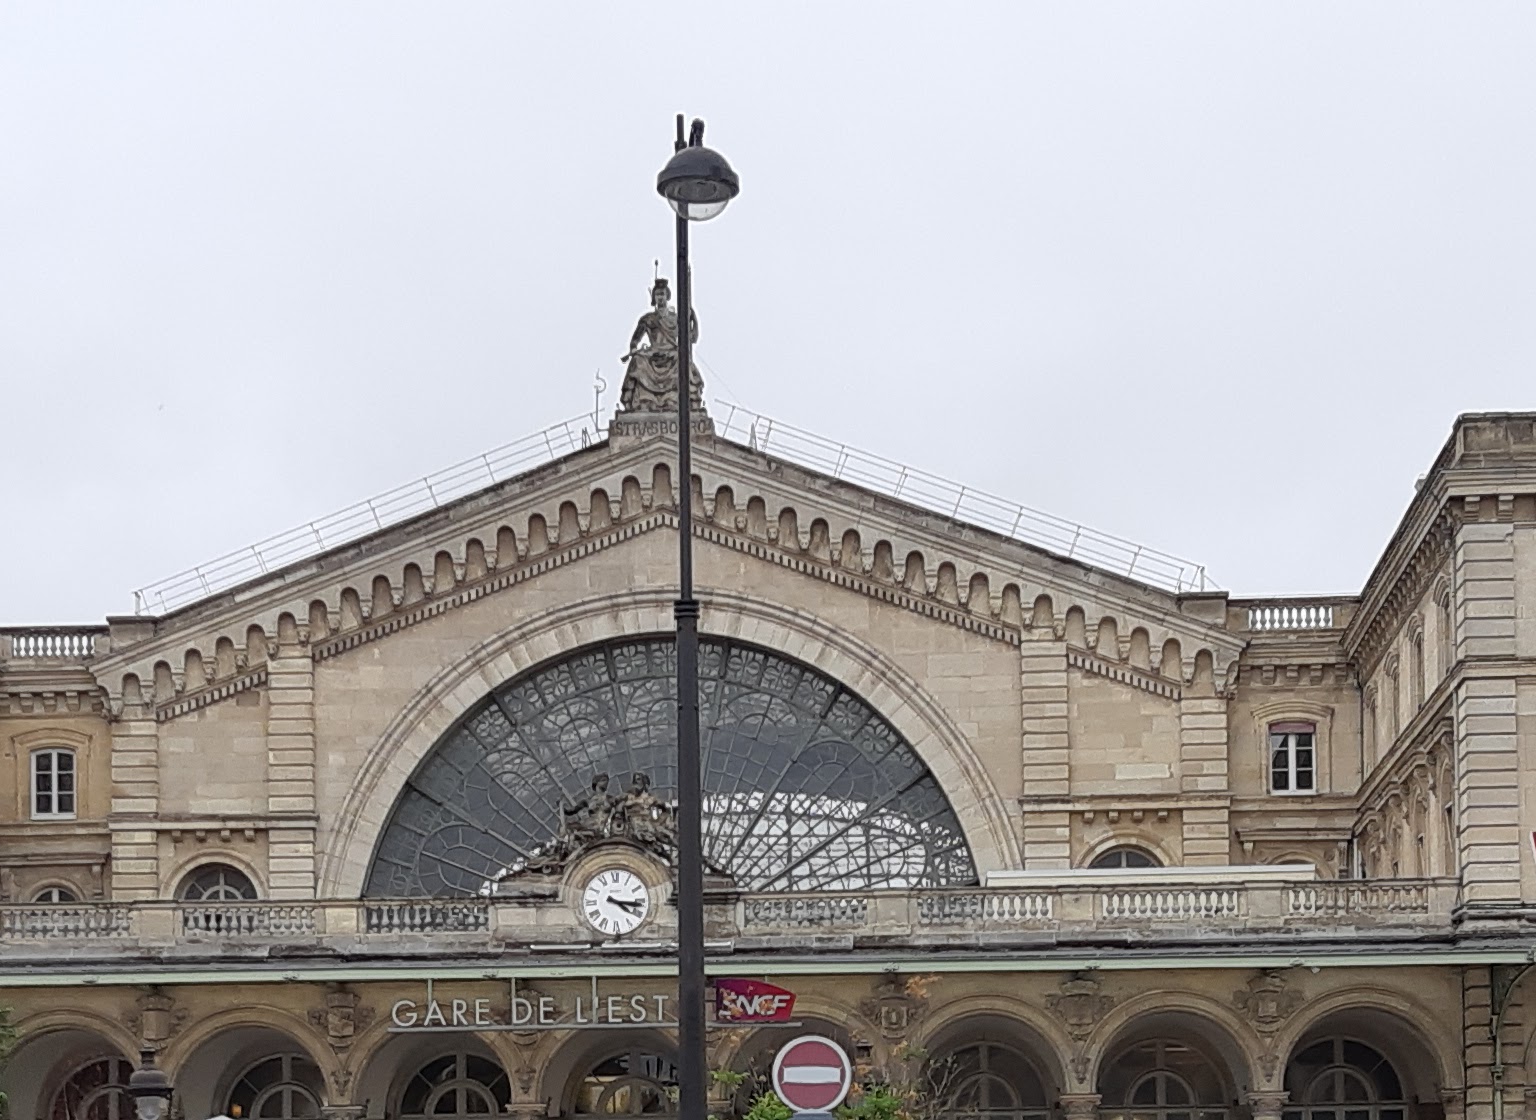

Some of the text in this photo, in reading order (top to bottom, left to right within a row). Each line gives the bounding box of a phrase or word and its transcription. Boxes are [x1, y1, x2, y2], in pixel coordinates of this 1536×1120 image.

[391, 995, 670, 1027] GARE DE L'EST
